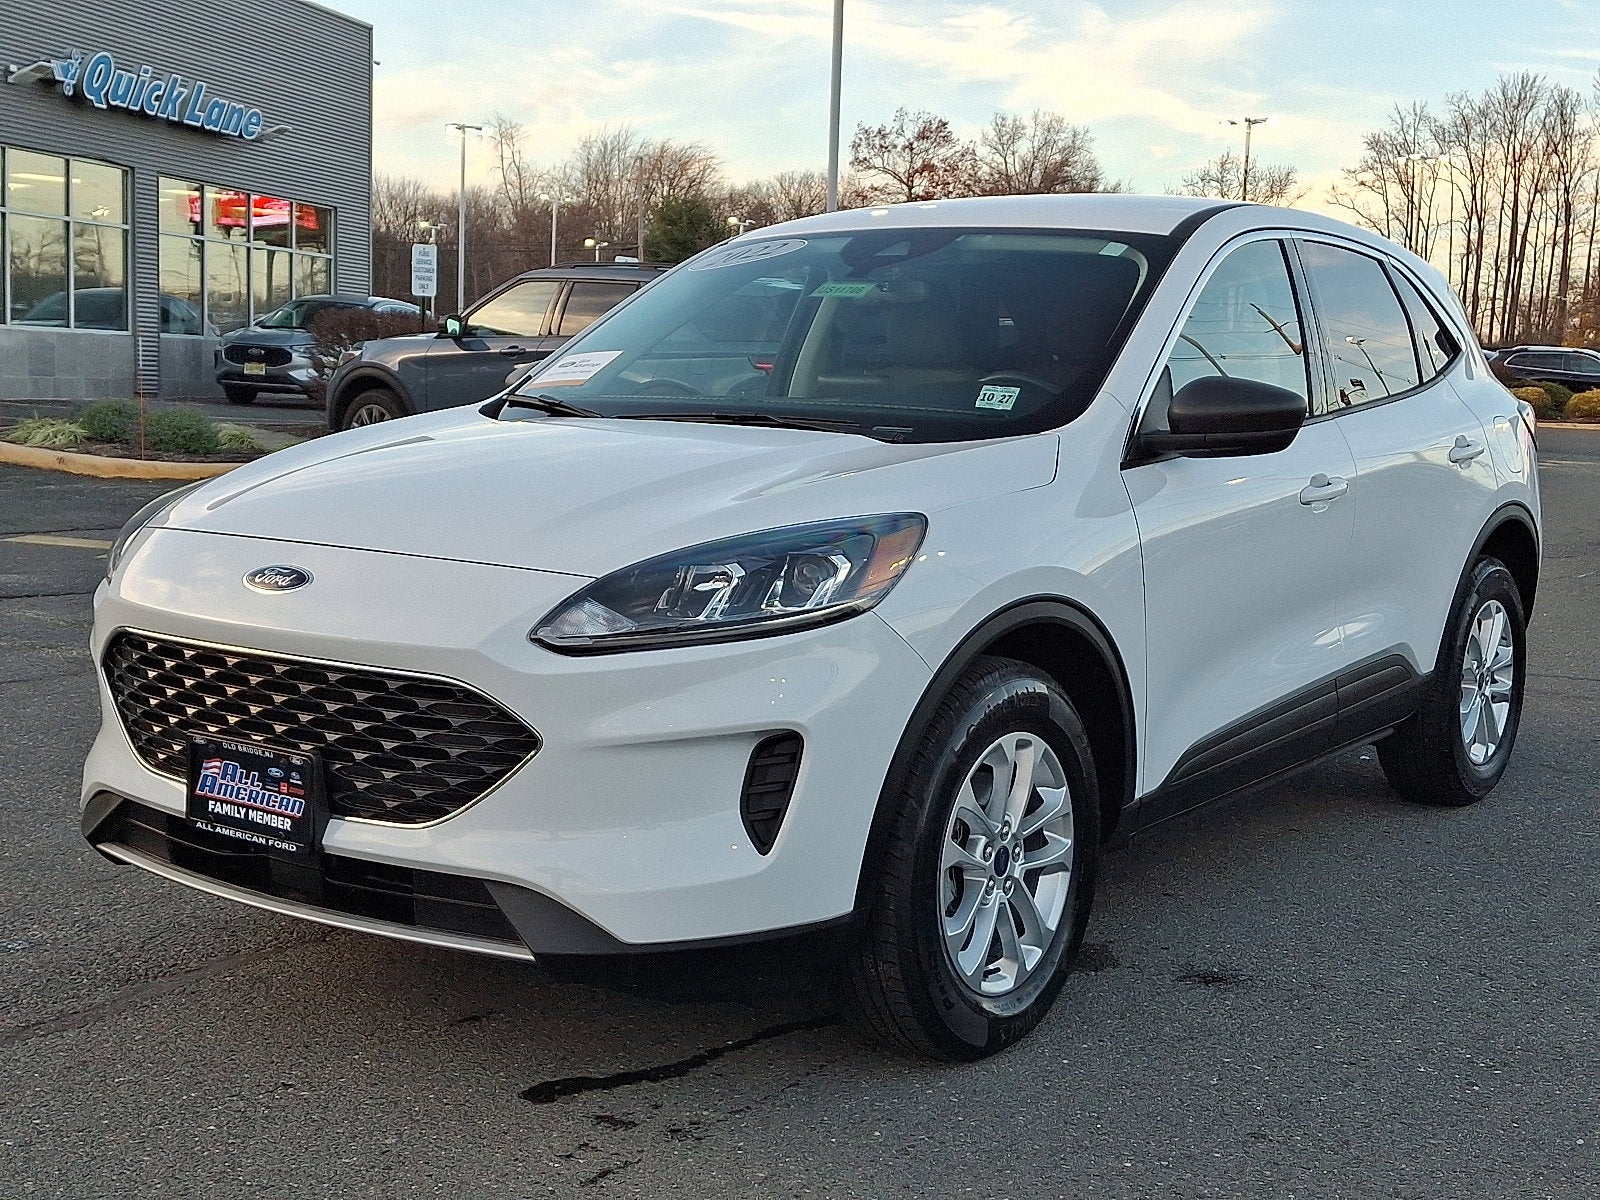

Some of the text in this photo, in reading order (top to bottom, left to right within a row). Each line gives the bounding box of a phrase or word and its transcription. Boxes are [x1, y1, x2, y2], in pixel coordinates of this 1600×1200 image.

[83, 51, 263, 140] Quick Lane
[980, 392, 1013, 404] 10 27
[219, 760, 263, 790] ALL
[196, 773, 306, 817] AMERICAN
[208, 800, 292, 831] FAMILY MEMBER
[195, 821, 297, 852] ALL AMERICAN FORD
